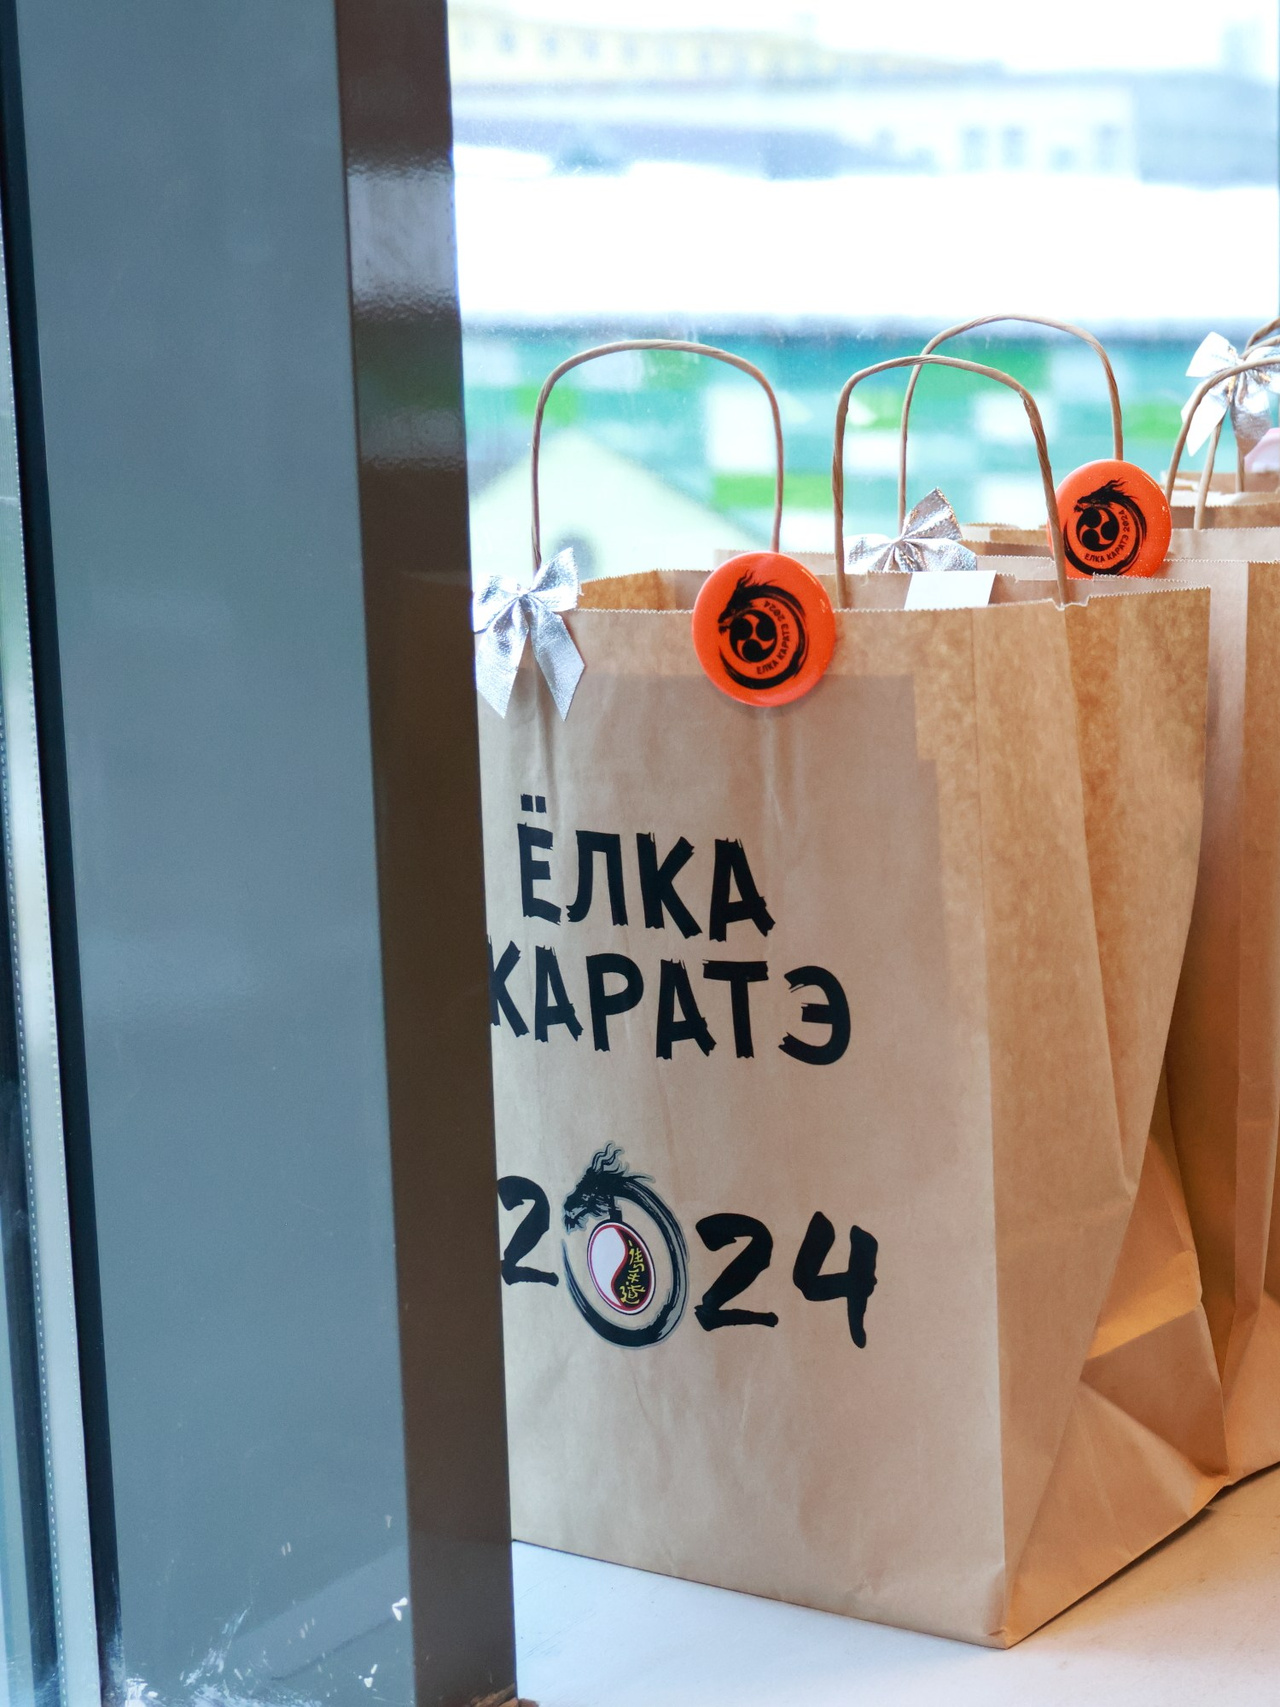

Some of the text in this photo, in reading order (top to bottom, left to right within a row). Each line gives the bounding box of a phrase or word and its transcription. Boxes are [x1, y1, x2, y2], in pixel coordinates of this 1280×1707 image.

[1084, 510, 1131, 563] ЕЛКА КАРАТЭ 2024
[763, 601, 786, 622] 2024
[517, 793, 776, 942] ЁЛКА
[487, 934, 852, 1066] КАРАТЭ
